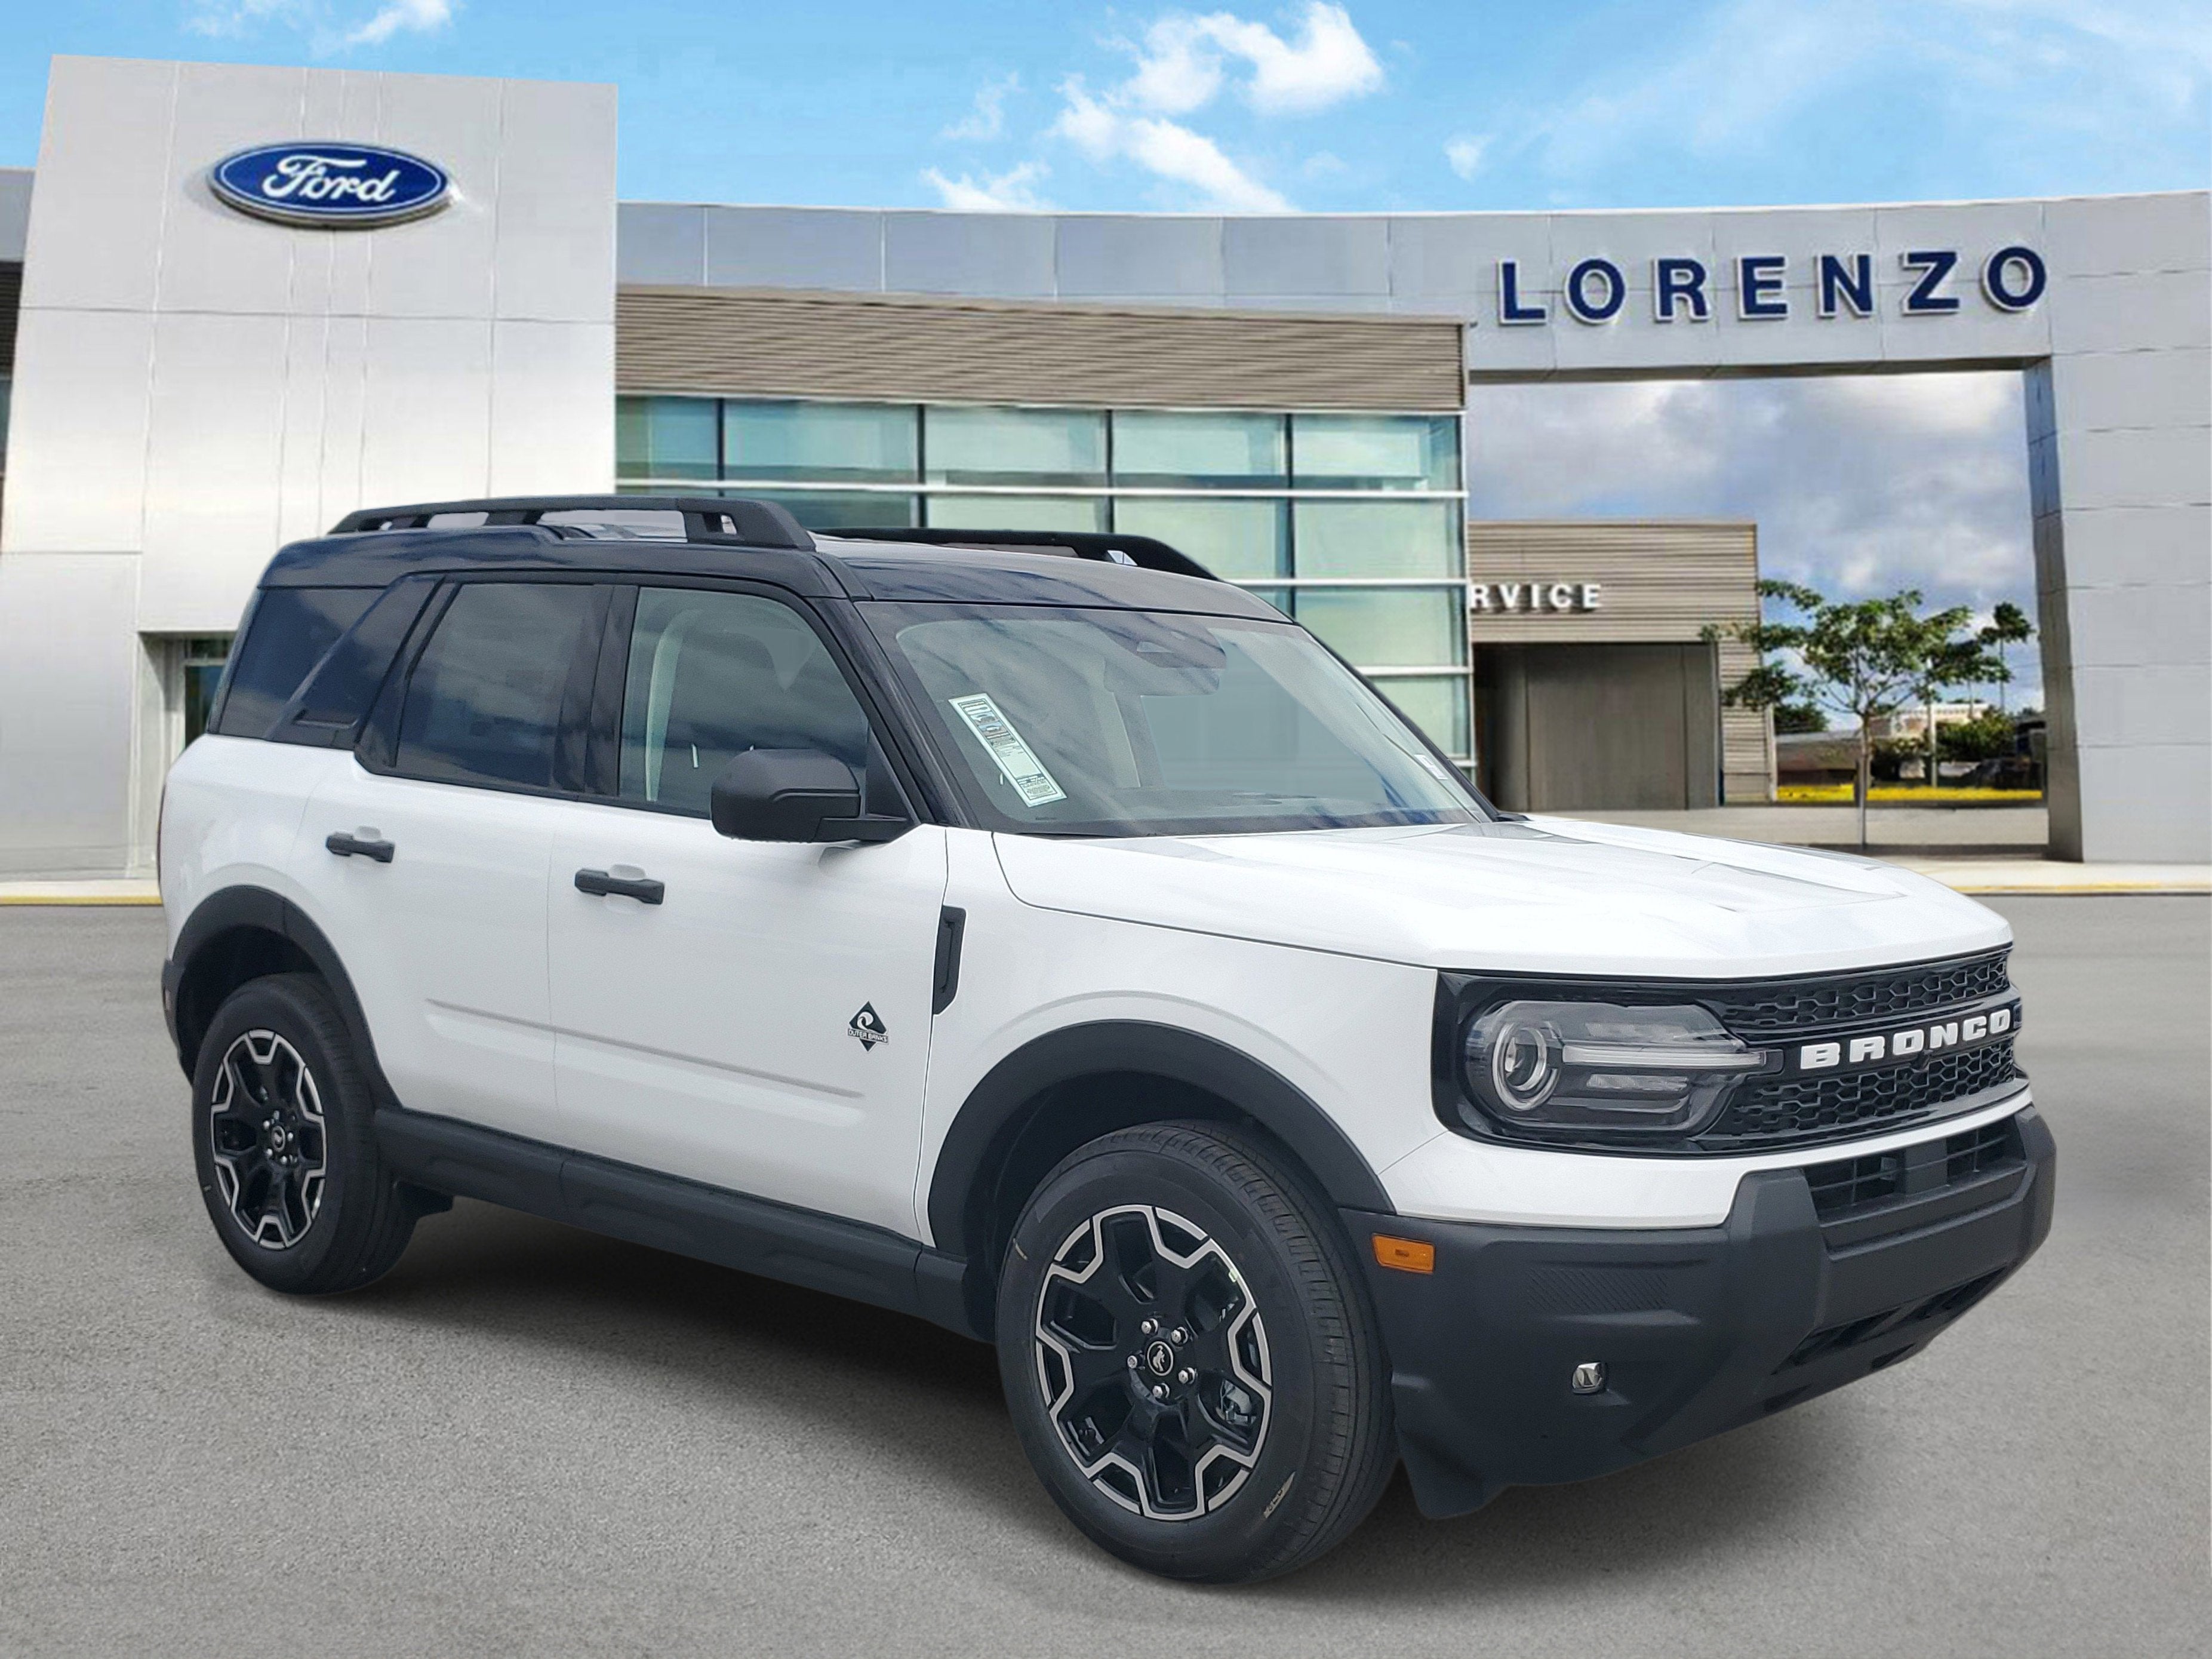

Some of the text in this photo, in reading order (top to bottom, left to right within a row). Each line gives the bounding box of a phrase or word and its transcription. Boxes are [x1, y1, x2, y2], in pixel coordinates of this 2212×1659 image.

[262, 153, 401, 202] Ford
[1497, 246, 2047, 324] LORENZO
[1470, 583, 1602, 609] RVICE
[848, 1029, 867, 1039] OUTER
[1800, 1008, 2011, 1070] BRONCO
